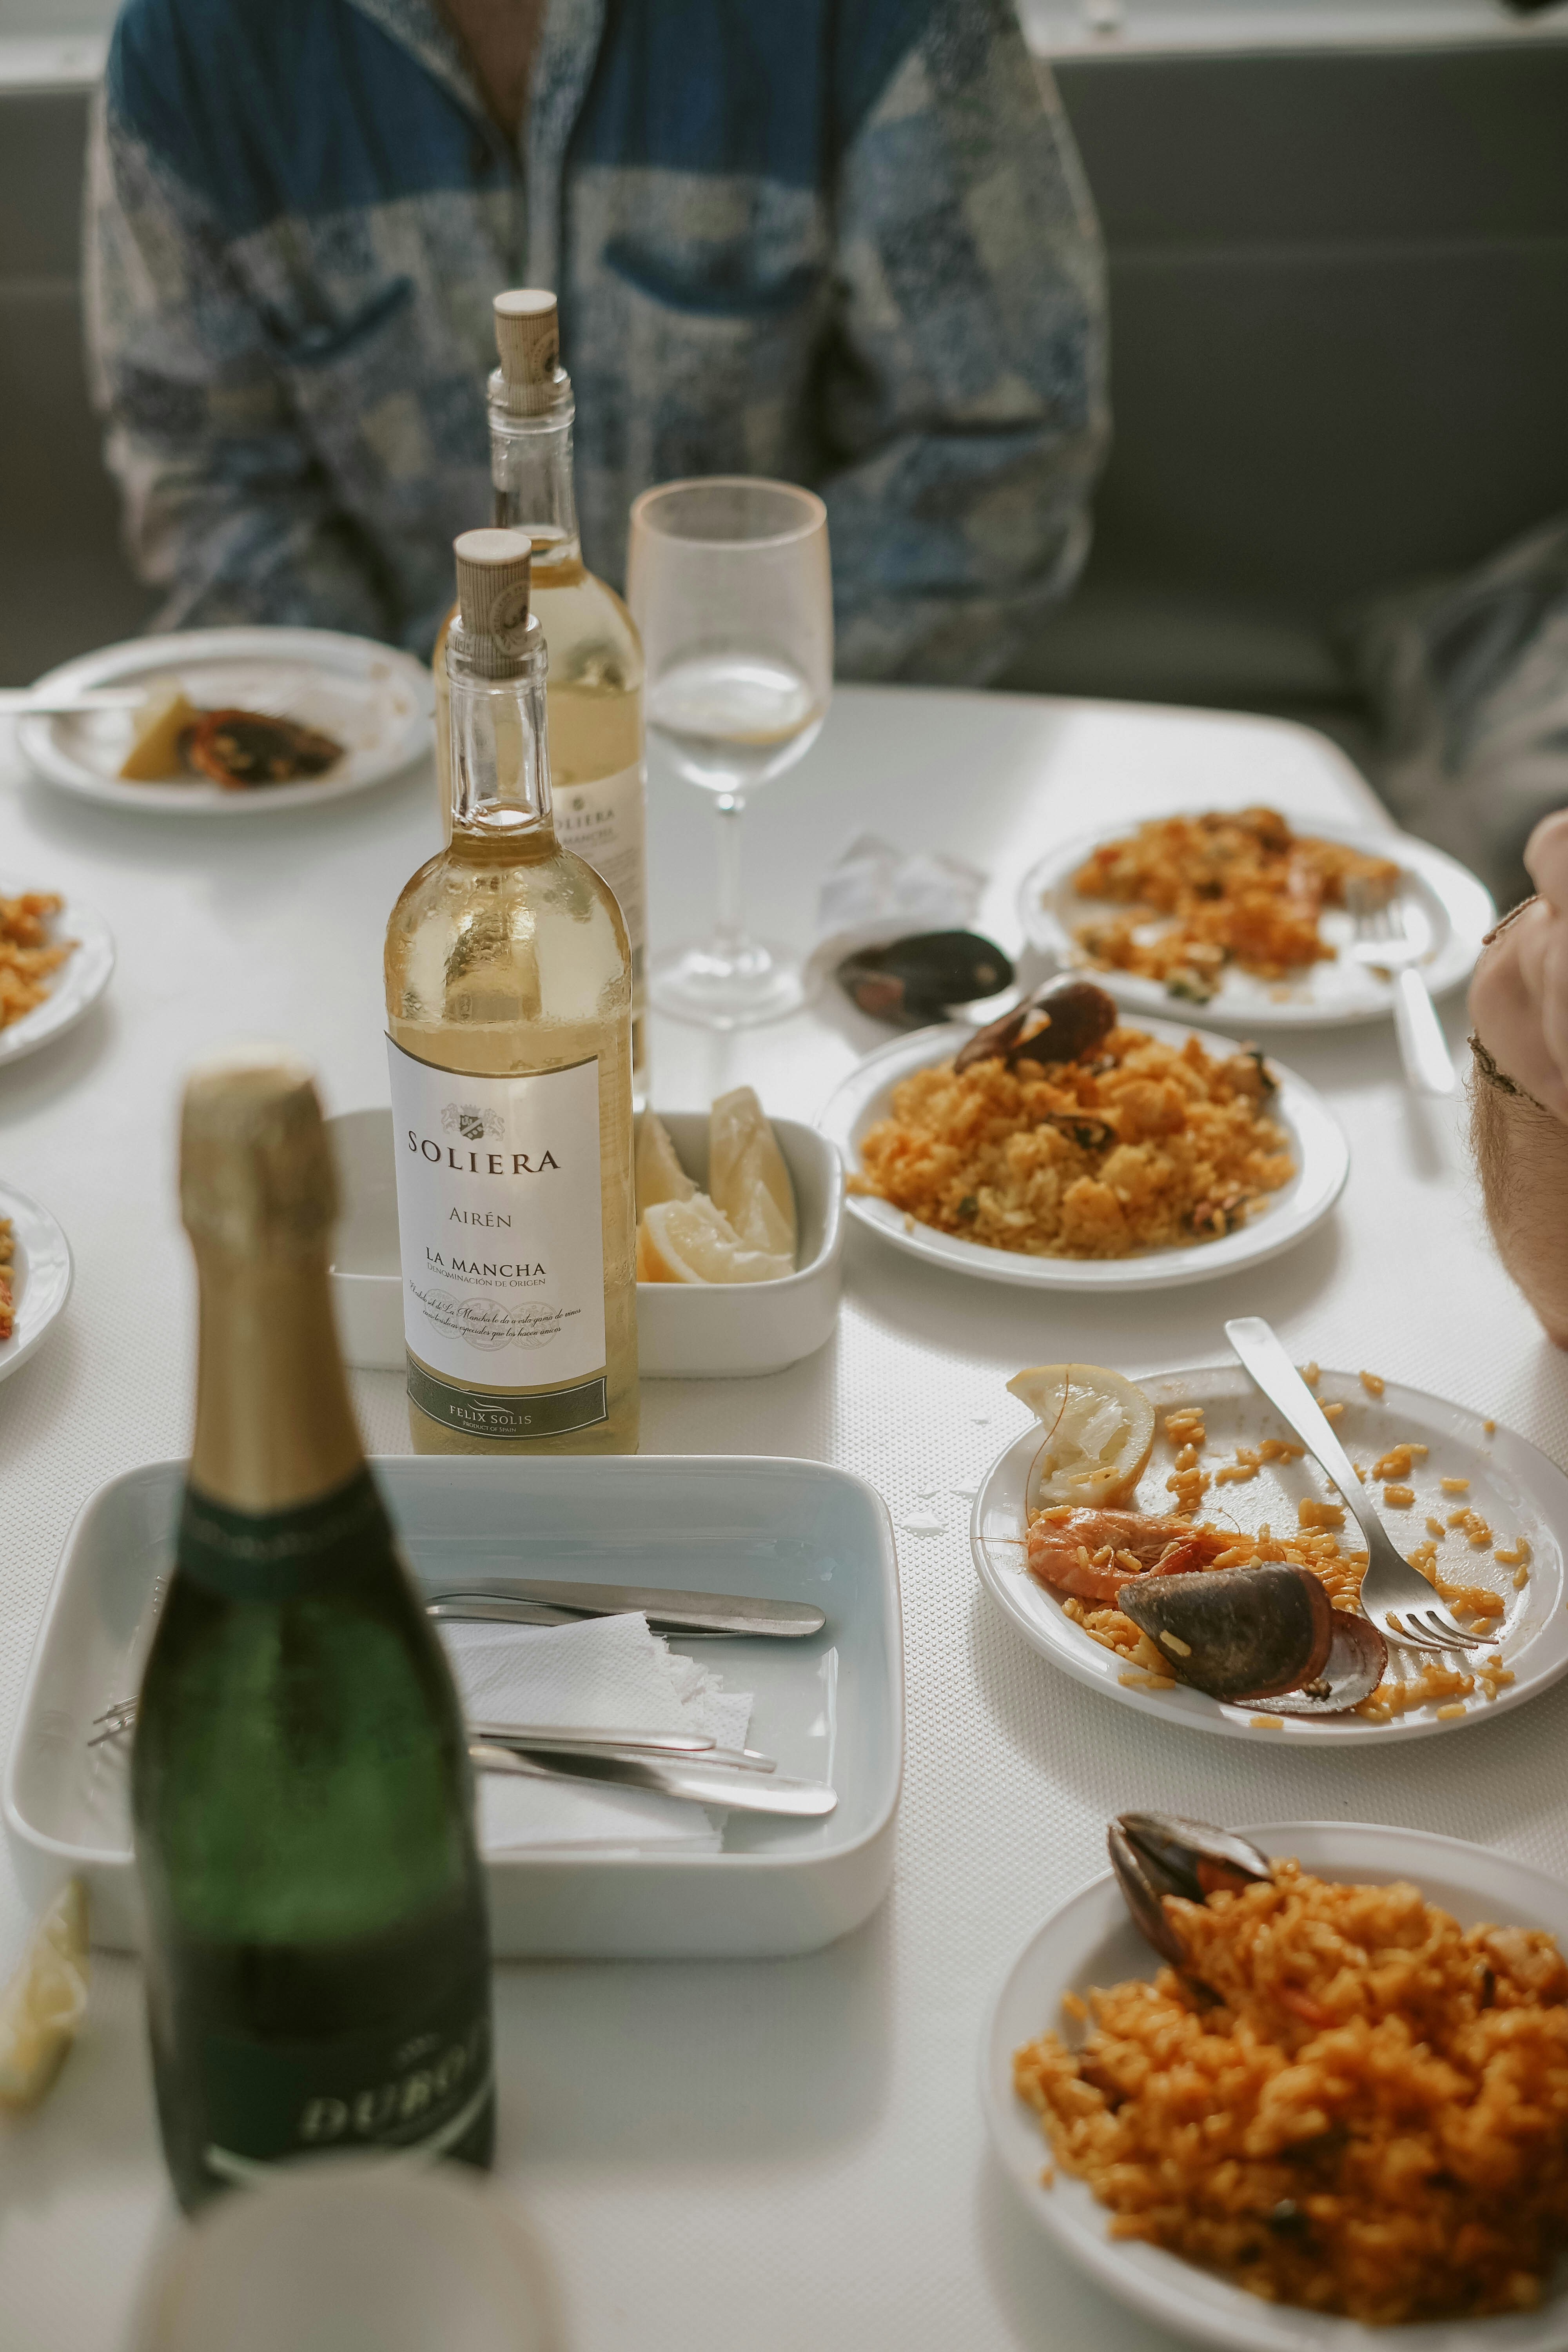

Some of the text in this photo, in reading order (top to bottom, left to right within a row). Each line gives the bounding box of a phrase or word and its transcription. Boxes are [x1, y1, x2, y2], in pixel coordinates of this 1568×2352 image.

[408, 1130, 561, 1174] SOLIERA
[449, 1207, 511, 1227] AIRÉN
[426, 1246, 546, 1277] LA MANCHA
[510, 1278, 546, 1287] ORIGEN
[442, 1304, 454, 1315] La
[456, 1308, 490, 1323] Mancha
[492, 1314, 499, 1323] le
[500, 1314, 509, 1324] da
[518, 1314, 532, 1323] esta
[532, 1316, 553, 1327] gama
[555, 1308, 563, 1319] de
[565, 1308, 581, 1317] vinos
[460, 1326, 490, 1336] especiales
[490, 1332, 504, 1341] que
[506, 1327, 515, 1337] los
[517, 1327, 538, 1337] hacen
[450, 1405, 532, 1424] FELIX SOLIS
[463, 1420, 489, 1430] PRODUCT
